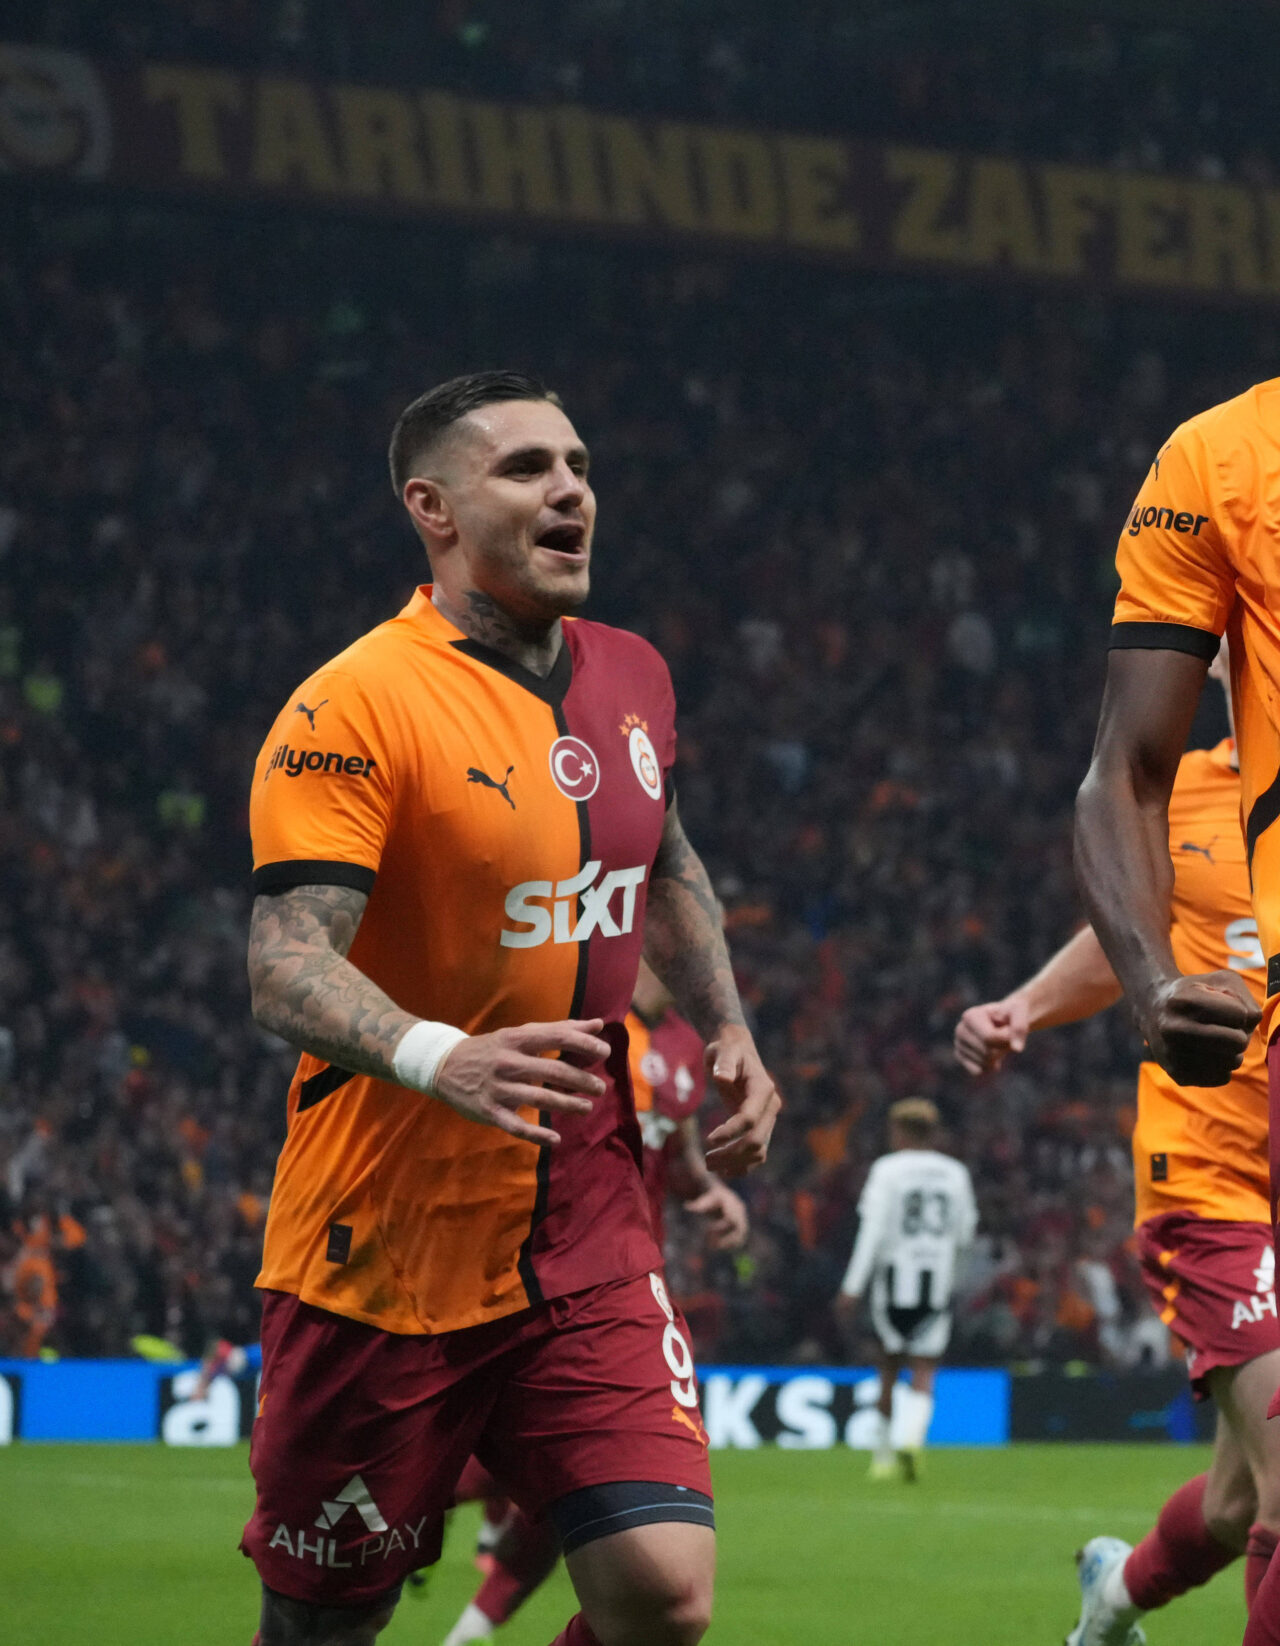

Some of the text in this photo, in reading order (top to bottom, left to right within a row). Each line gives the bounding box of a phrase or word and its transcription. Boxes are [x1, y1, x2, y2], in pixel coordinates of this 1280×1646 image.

[662, 1321, 698, 1408] 9
[269, 1515, 427, 1568] AHL PAY
